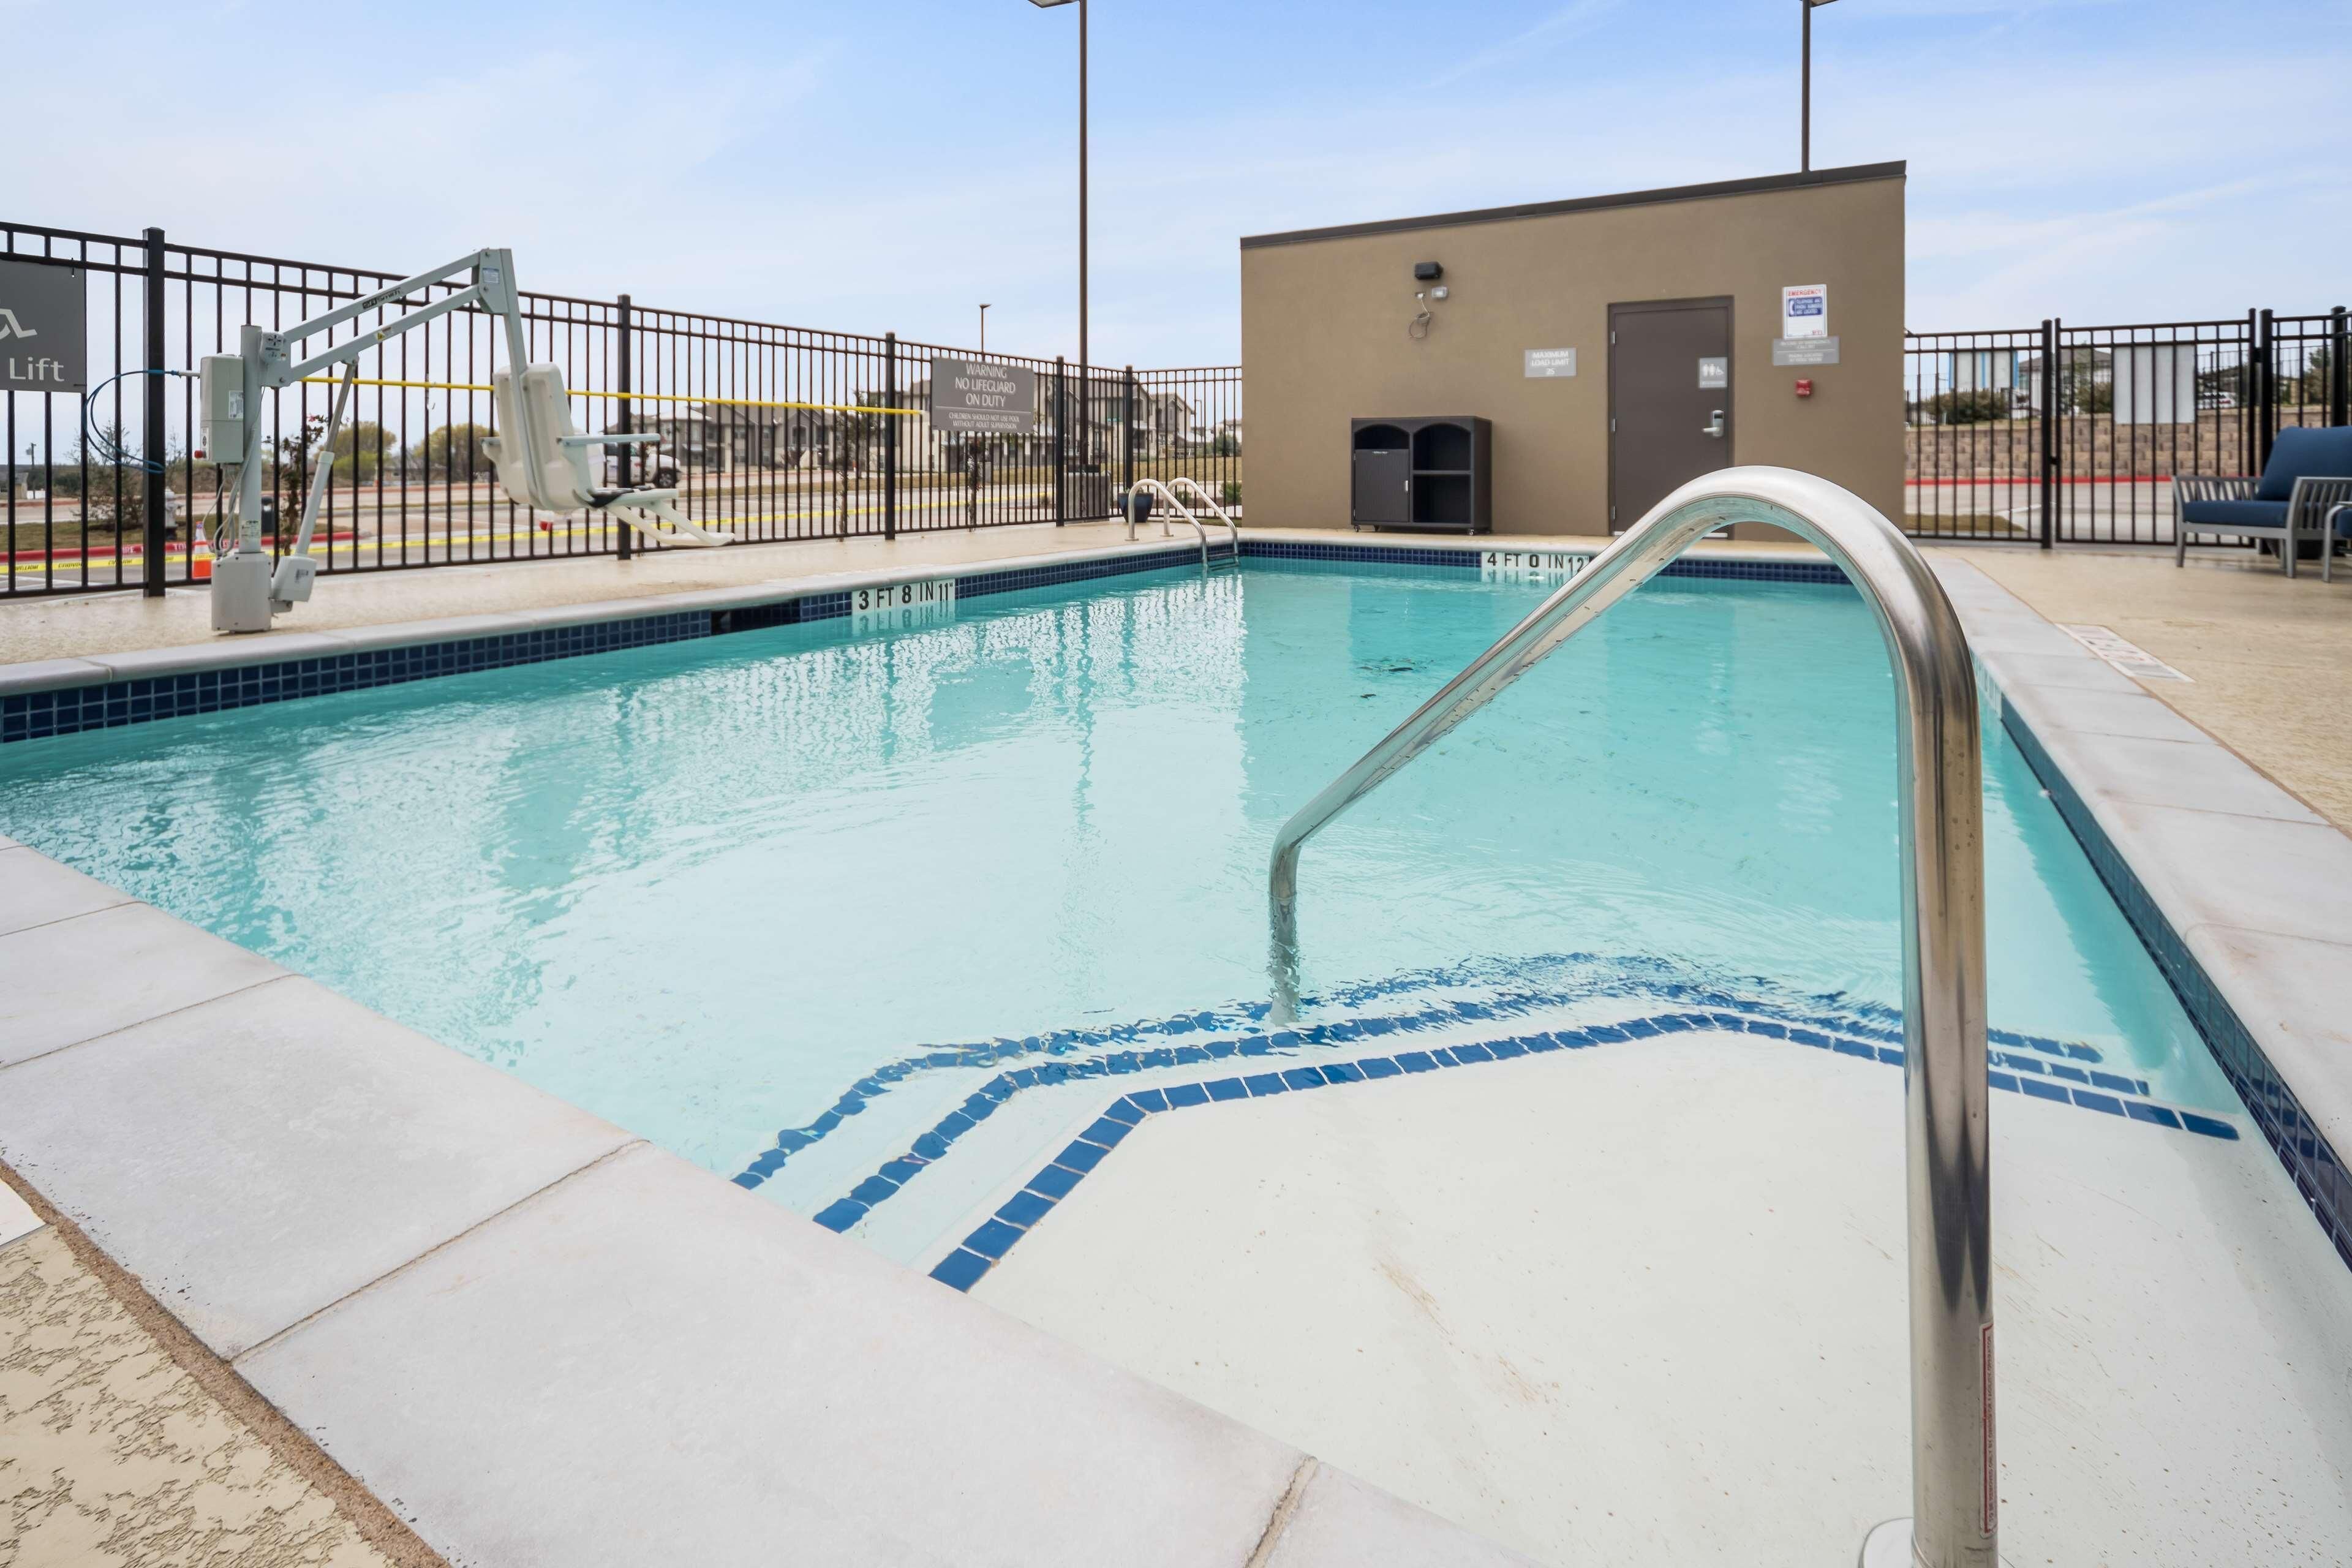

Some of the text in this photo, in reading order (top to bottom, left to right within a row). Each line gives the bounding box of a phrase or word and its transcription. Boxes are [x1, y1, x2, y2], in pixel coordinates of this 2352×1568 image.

[9, 356, 65, 382] Lift
[965, 363, 1008, 379] WARNING
[954, 377, 1016, 393] NO LIFEGUARD
[965, 393, 1006, 407] ON DUTY
[1487, 552, 1498, 567] 4
[1504, 553, 1521, 567] FT
[1548, 554, 1564, 569] IN
[859, 590, 870, 610] 3
[876, 586, 894, 608] FT
[902, 584, 912, 604] 8
[920, 581, 934, 602] IN
